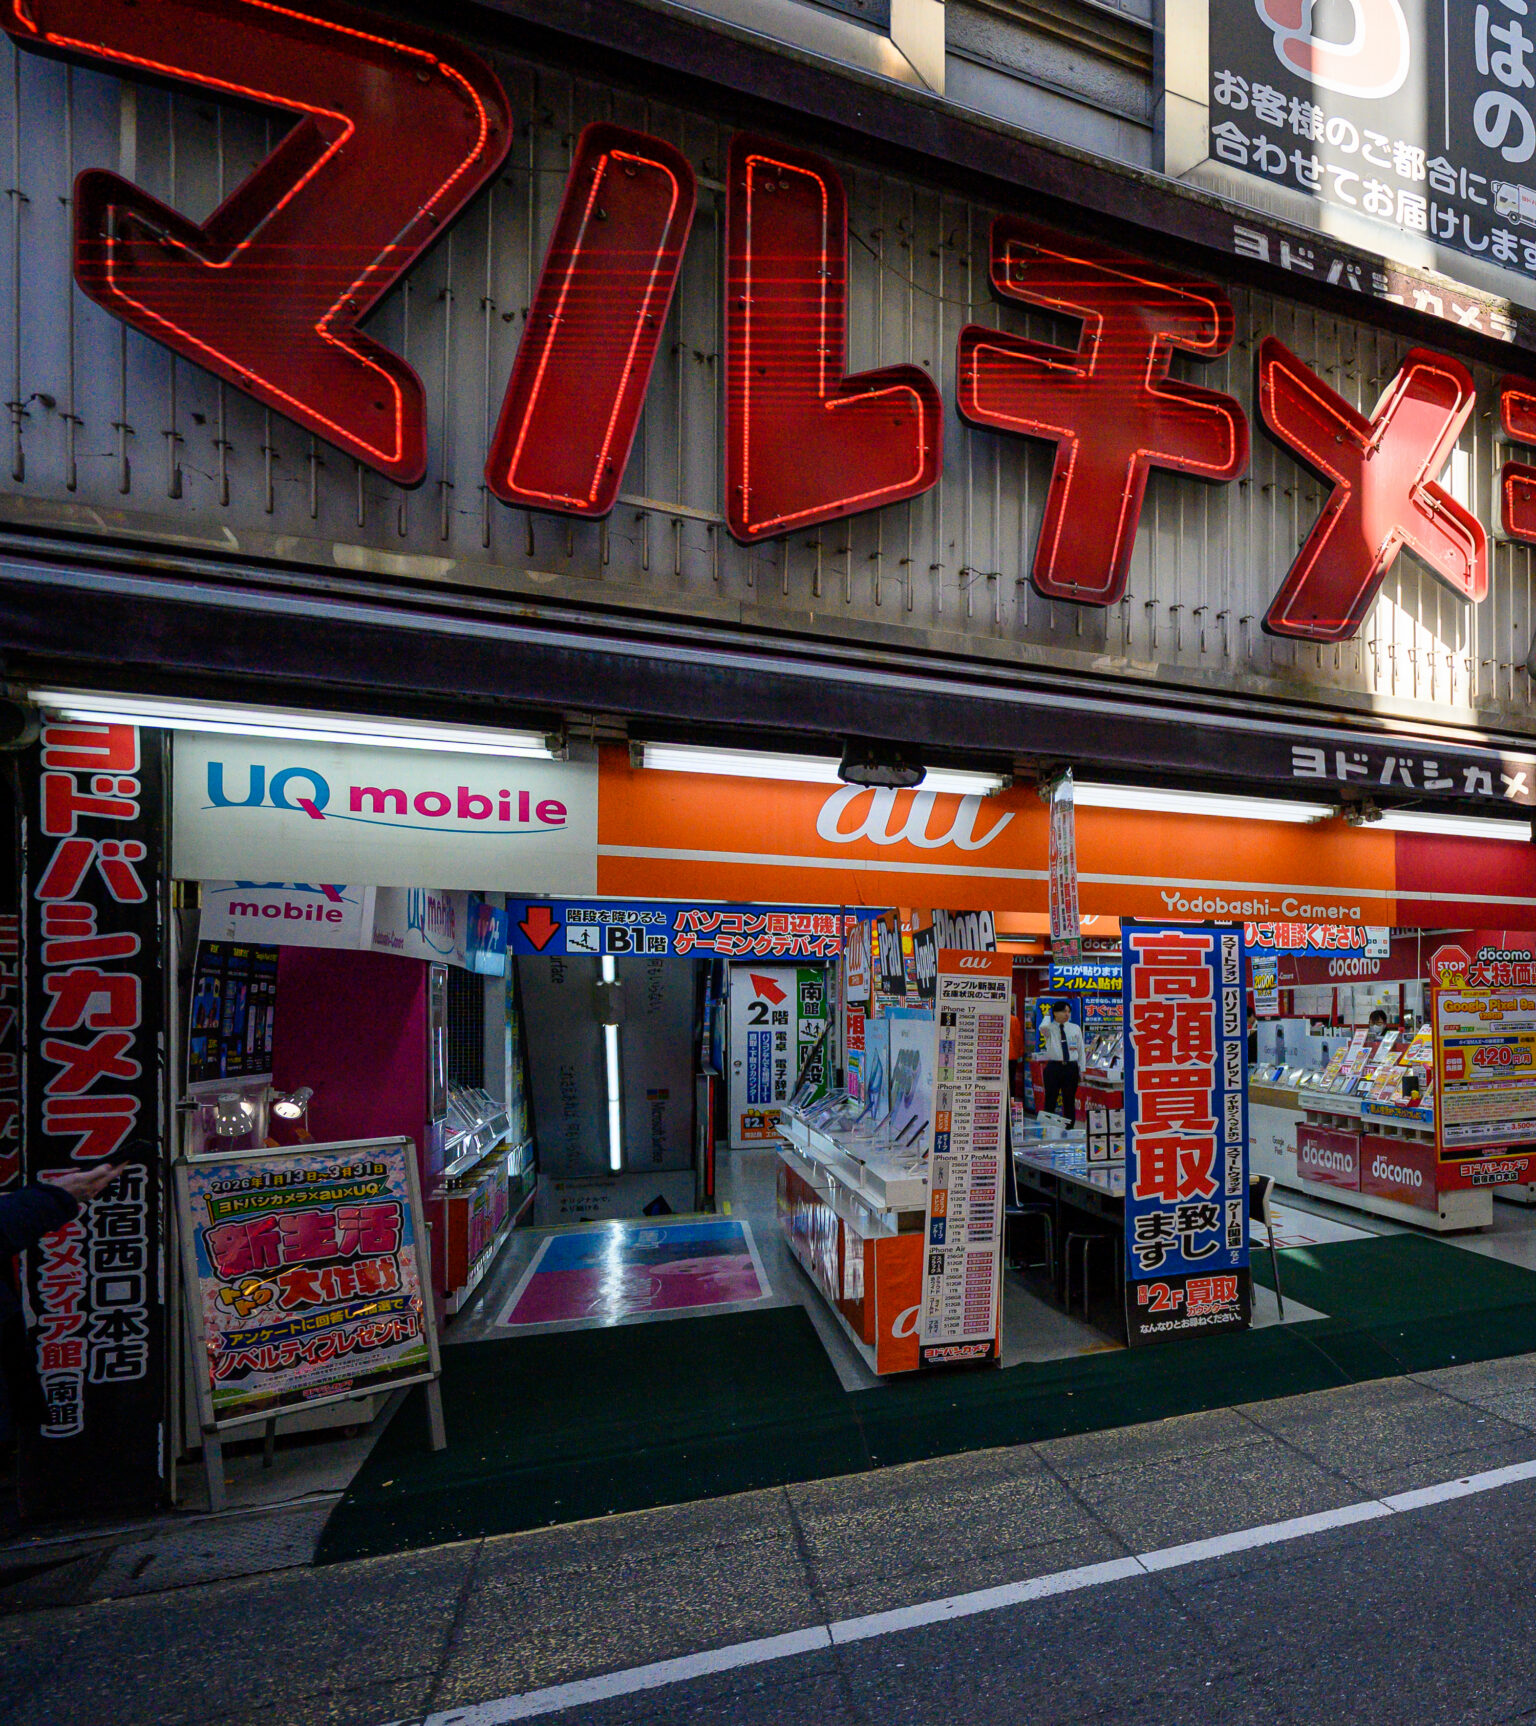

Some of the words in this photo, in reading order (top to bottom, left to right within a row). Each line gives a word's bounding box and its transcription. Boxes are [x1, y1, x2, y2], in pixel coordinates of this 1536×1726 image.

[1213, 69, 1488, 206] お客様のご都合に
[1232, 223, 1518, 342] ヨドバシカメラ
[207, 761, 331, 820] UQ
[348, 785, 568, 825] mobile
[815, 784, 1016, 851] au
[228, 900, 344, 924] mobile
[566, 908, 667, 925] 階段を降りると
[1160, 890, 1361, 920] Yodobashi-Camera
[34, 714, 148, 1160] ヨドバシカメラ
[673, 910, 858, 935] パソコン周辺機器
[606, 925, 668, 953] B1階
[959, 956, 992, 968] au
[1223, 936, 1238, 983] スマートフォン
[1328, 957, 1380, 977] docomo
[1437, 961, 1465, 972] STOP
[1478, 949, 1531, 961] docomo
[943, 980, 1006, 992] アップル新製品
[1053, 977, 1122, 990] フィルム貼付
[1470, 961, 1530, 987] 大特価
[801, 982, 823, 1016] 南館
[942, 990, 1006, 1001] 在庫状況のご案内
[1444, 999, 1487, 1013] Google
[1489, 998, 1518, 1012] Pixel
[1519, 998, 1536, 1011] 9a
[747, 1002, 789, 1027] 2階
[1224, 990, 1239, 1034] パソコン
[774, 1031, 788, 1052] 電卓
[1129, 931, 1220, 1203] 高額買取
[1225, 1042, 1239, 1088] タブレット
[1272, 1135, 1284, 1146] Google
[1302, 1139, 1353, 1173] docomo
[933, 1154, 958, 1162] iPhone
[1227, 1147, 1240, 1194] スマートウォッチ
[1372, 1155, 1423, 1188] docomo
[1460, 1158, 1530, 1177] ヨドバシカメラ
[1227, 1201, 1241, 1247] ゲーム関連
[205, 1203, 402, 1278] 新生活
[1132, 1211, 1178, 1271] ます
[88, 1162, 149, 1384] 新宿西口本店
[277, 1258, 401, 1310] 大作戦
[1149, 1282, 1184, 1312] 2F
[1186, 1275, 1239, 1306] 買取
[228, 1297, 405, 1347] アンケートに回答し、抽選で
[1140, 1313, 1242, 1334] なんなりとお尋ねください。
[215, 1316, 417, 1381] ノベルティプレゼント!
[924, 1343, 990, 1359] ヨドバシカメラ
